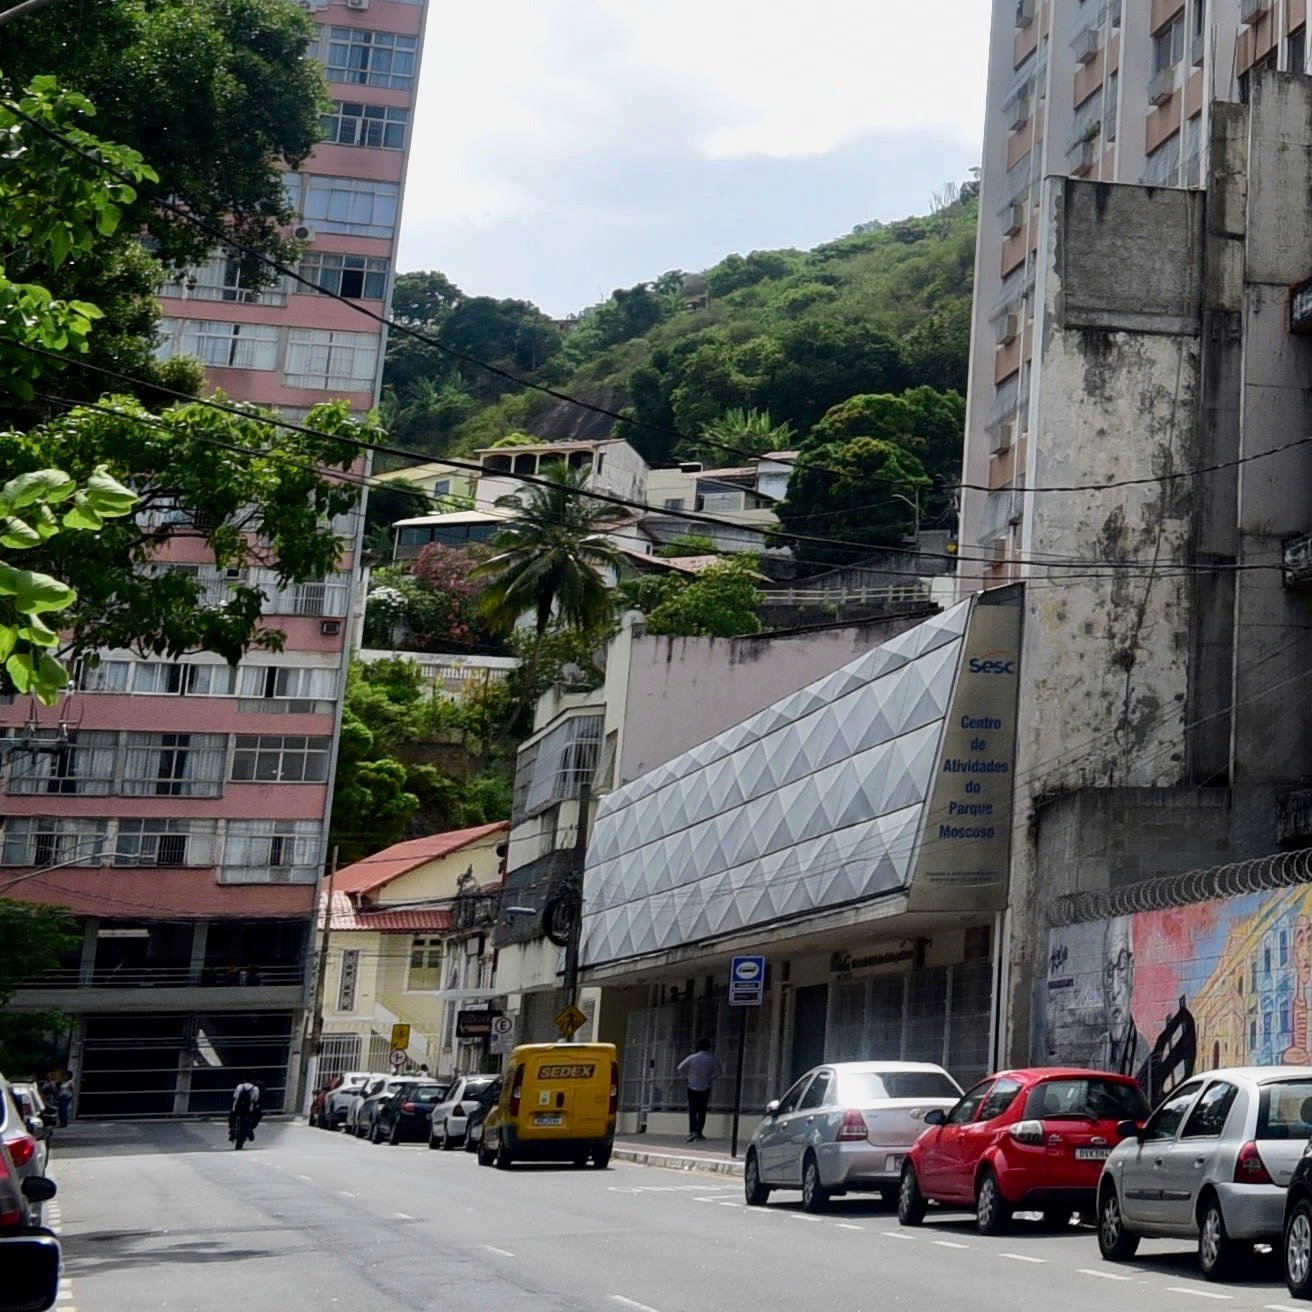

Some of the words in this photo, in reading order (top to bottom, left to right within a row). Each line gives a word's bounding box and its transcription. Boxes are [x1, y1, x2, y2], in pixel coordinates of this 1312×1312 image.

[969, 658, 1015, 674] Sesc
[960, 715, 1001, 730] Centro
[970, 737, 986, 751] de
[943, 758, 1008, 774] Atividades
[965, 779, 981, 794] do
[949, 801, 993, 816] Parque
[939, 824, 995, 839] Moscoso
[540, 1066, 593, 1078] SEDEX
